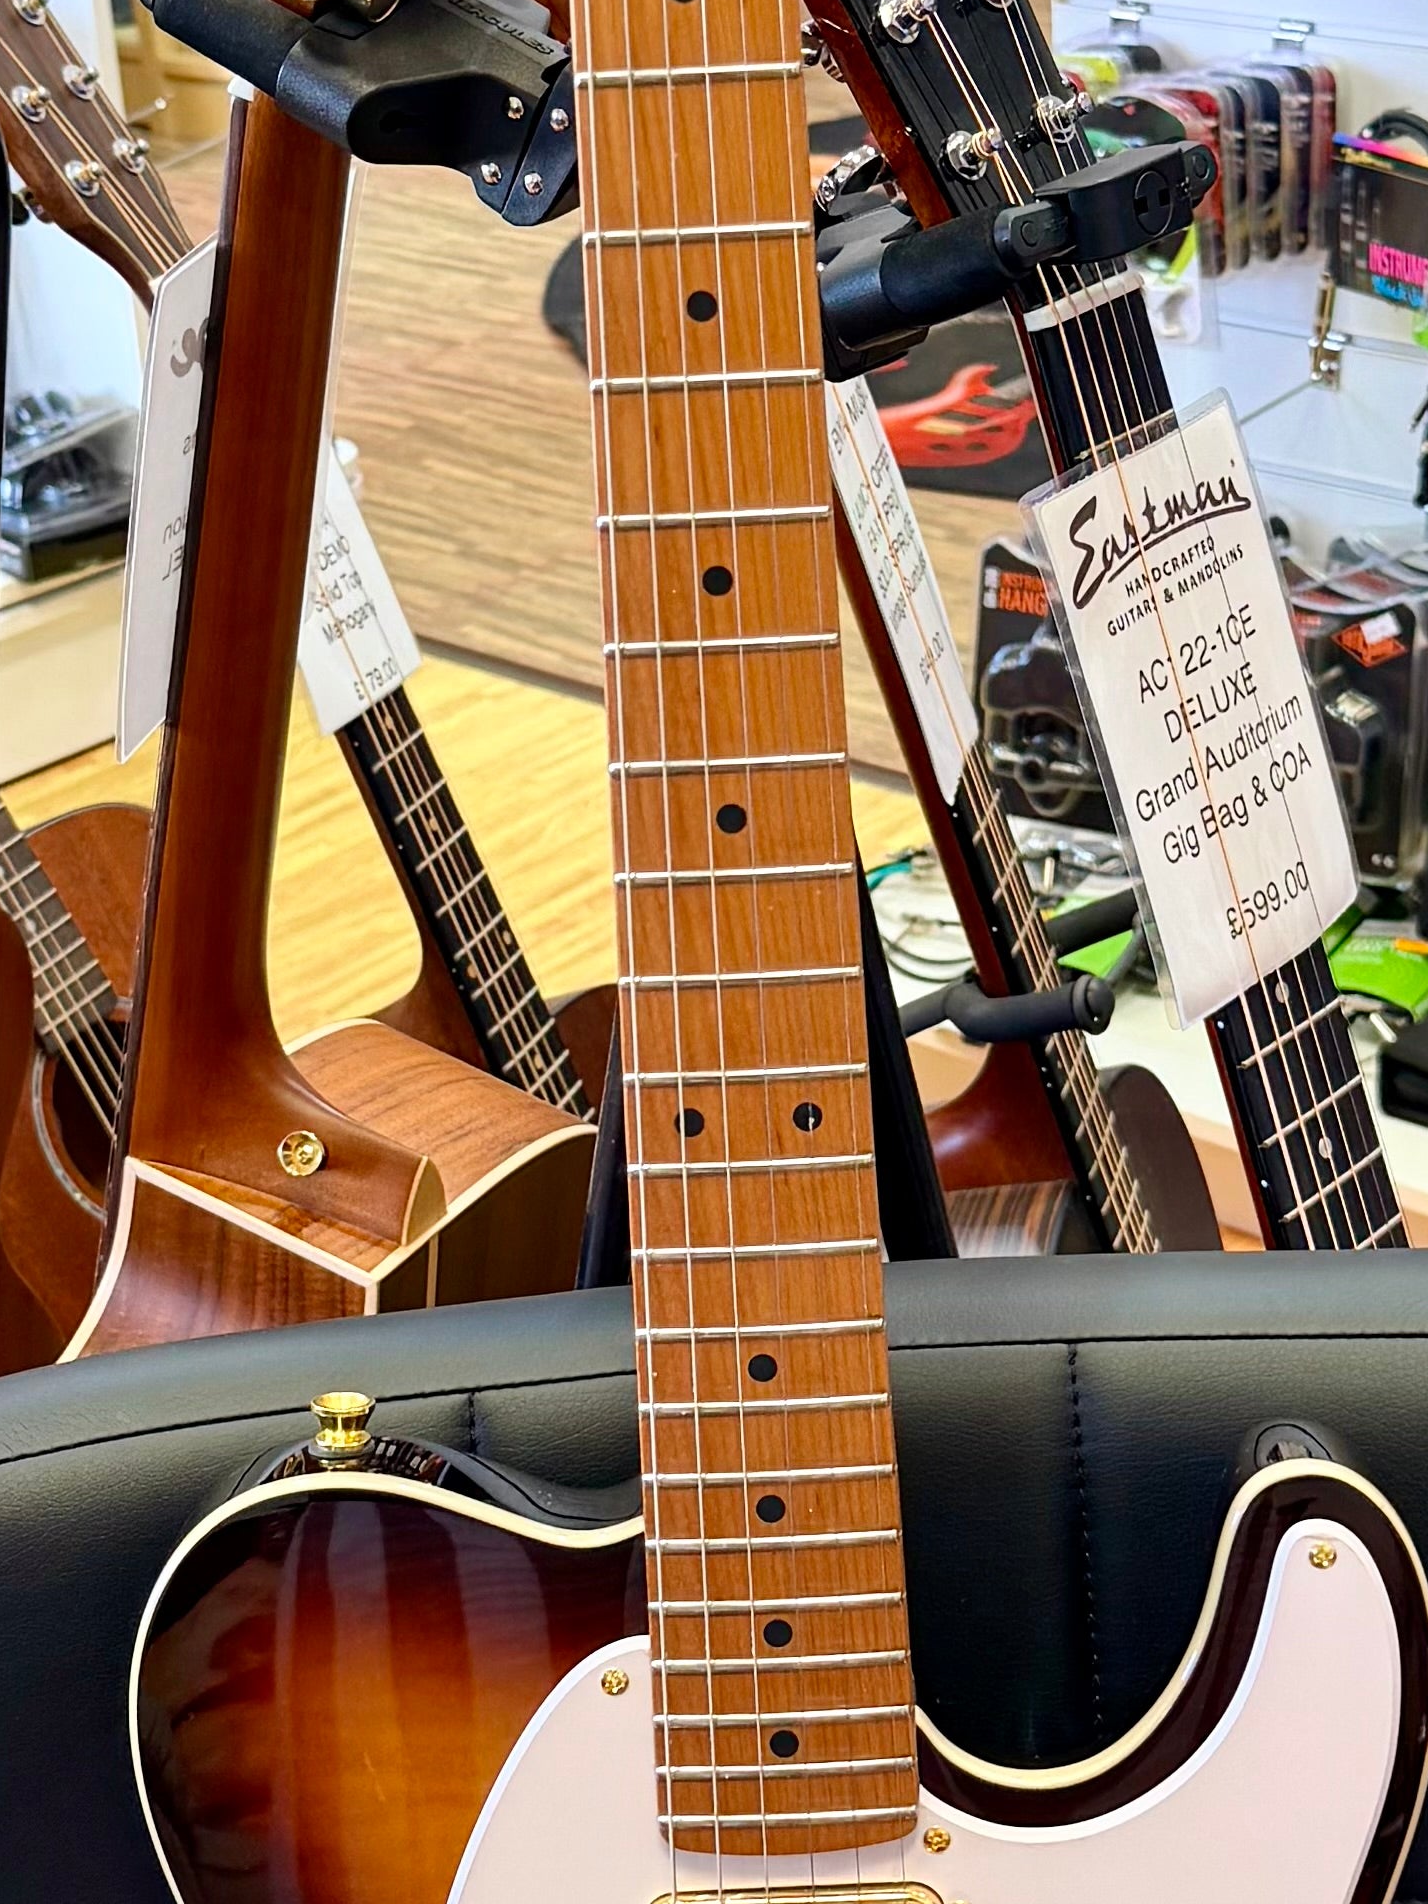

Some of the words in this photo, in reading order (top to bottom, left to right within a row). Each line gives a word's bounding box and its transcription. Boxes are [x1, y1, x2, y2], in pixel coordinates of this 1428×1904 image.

[1068, 475, 1253, 611] Eastman
[1124, 535, 1215, 599] HANDCRAFTED
[997, 588, 1049, 618] HANG
[1107, 595, 1158, 637] GUITARS
[1163, 588, 1174, 604] &
[1178, 543, 1245, 597] MANDOLINS
[354, 657, 398, 702] £79.00
[1138, 603, 1257, 705] AC22-1CE
[1164, 662, 1257, 744] DELUXE
[1135, 757, 1199, 823] Grand
[1205, 695, 1303, 779] Auditorium
[1163, 823, 1201, 865] Gig
[1200, 793, 1249, 840] Bag
[1252, 775, 1269, 808] &
[1269, 741, 1312, 794] COA
[1225, 860, 1310, 941] £599.00
